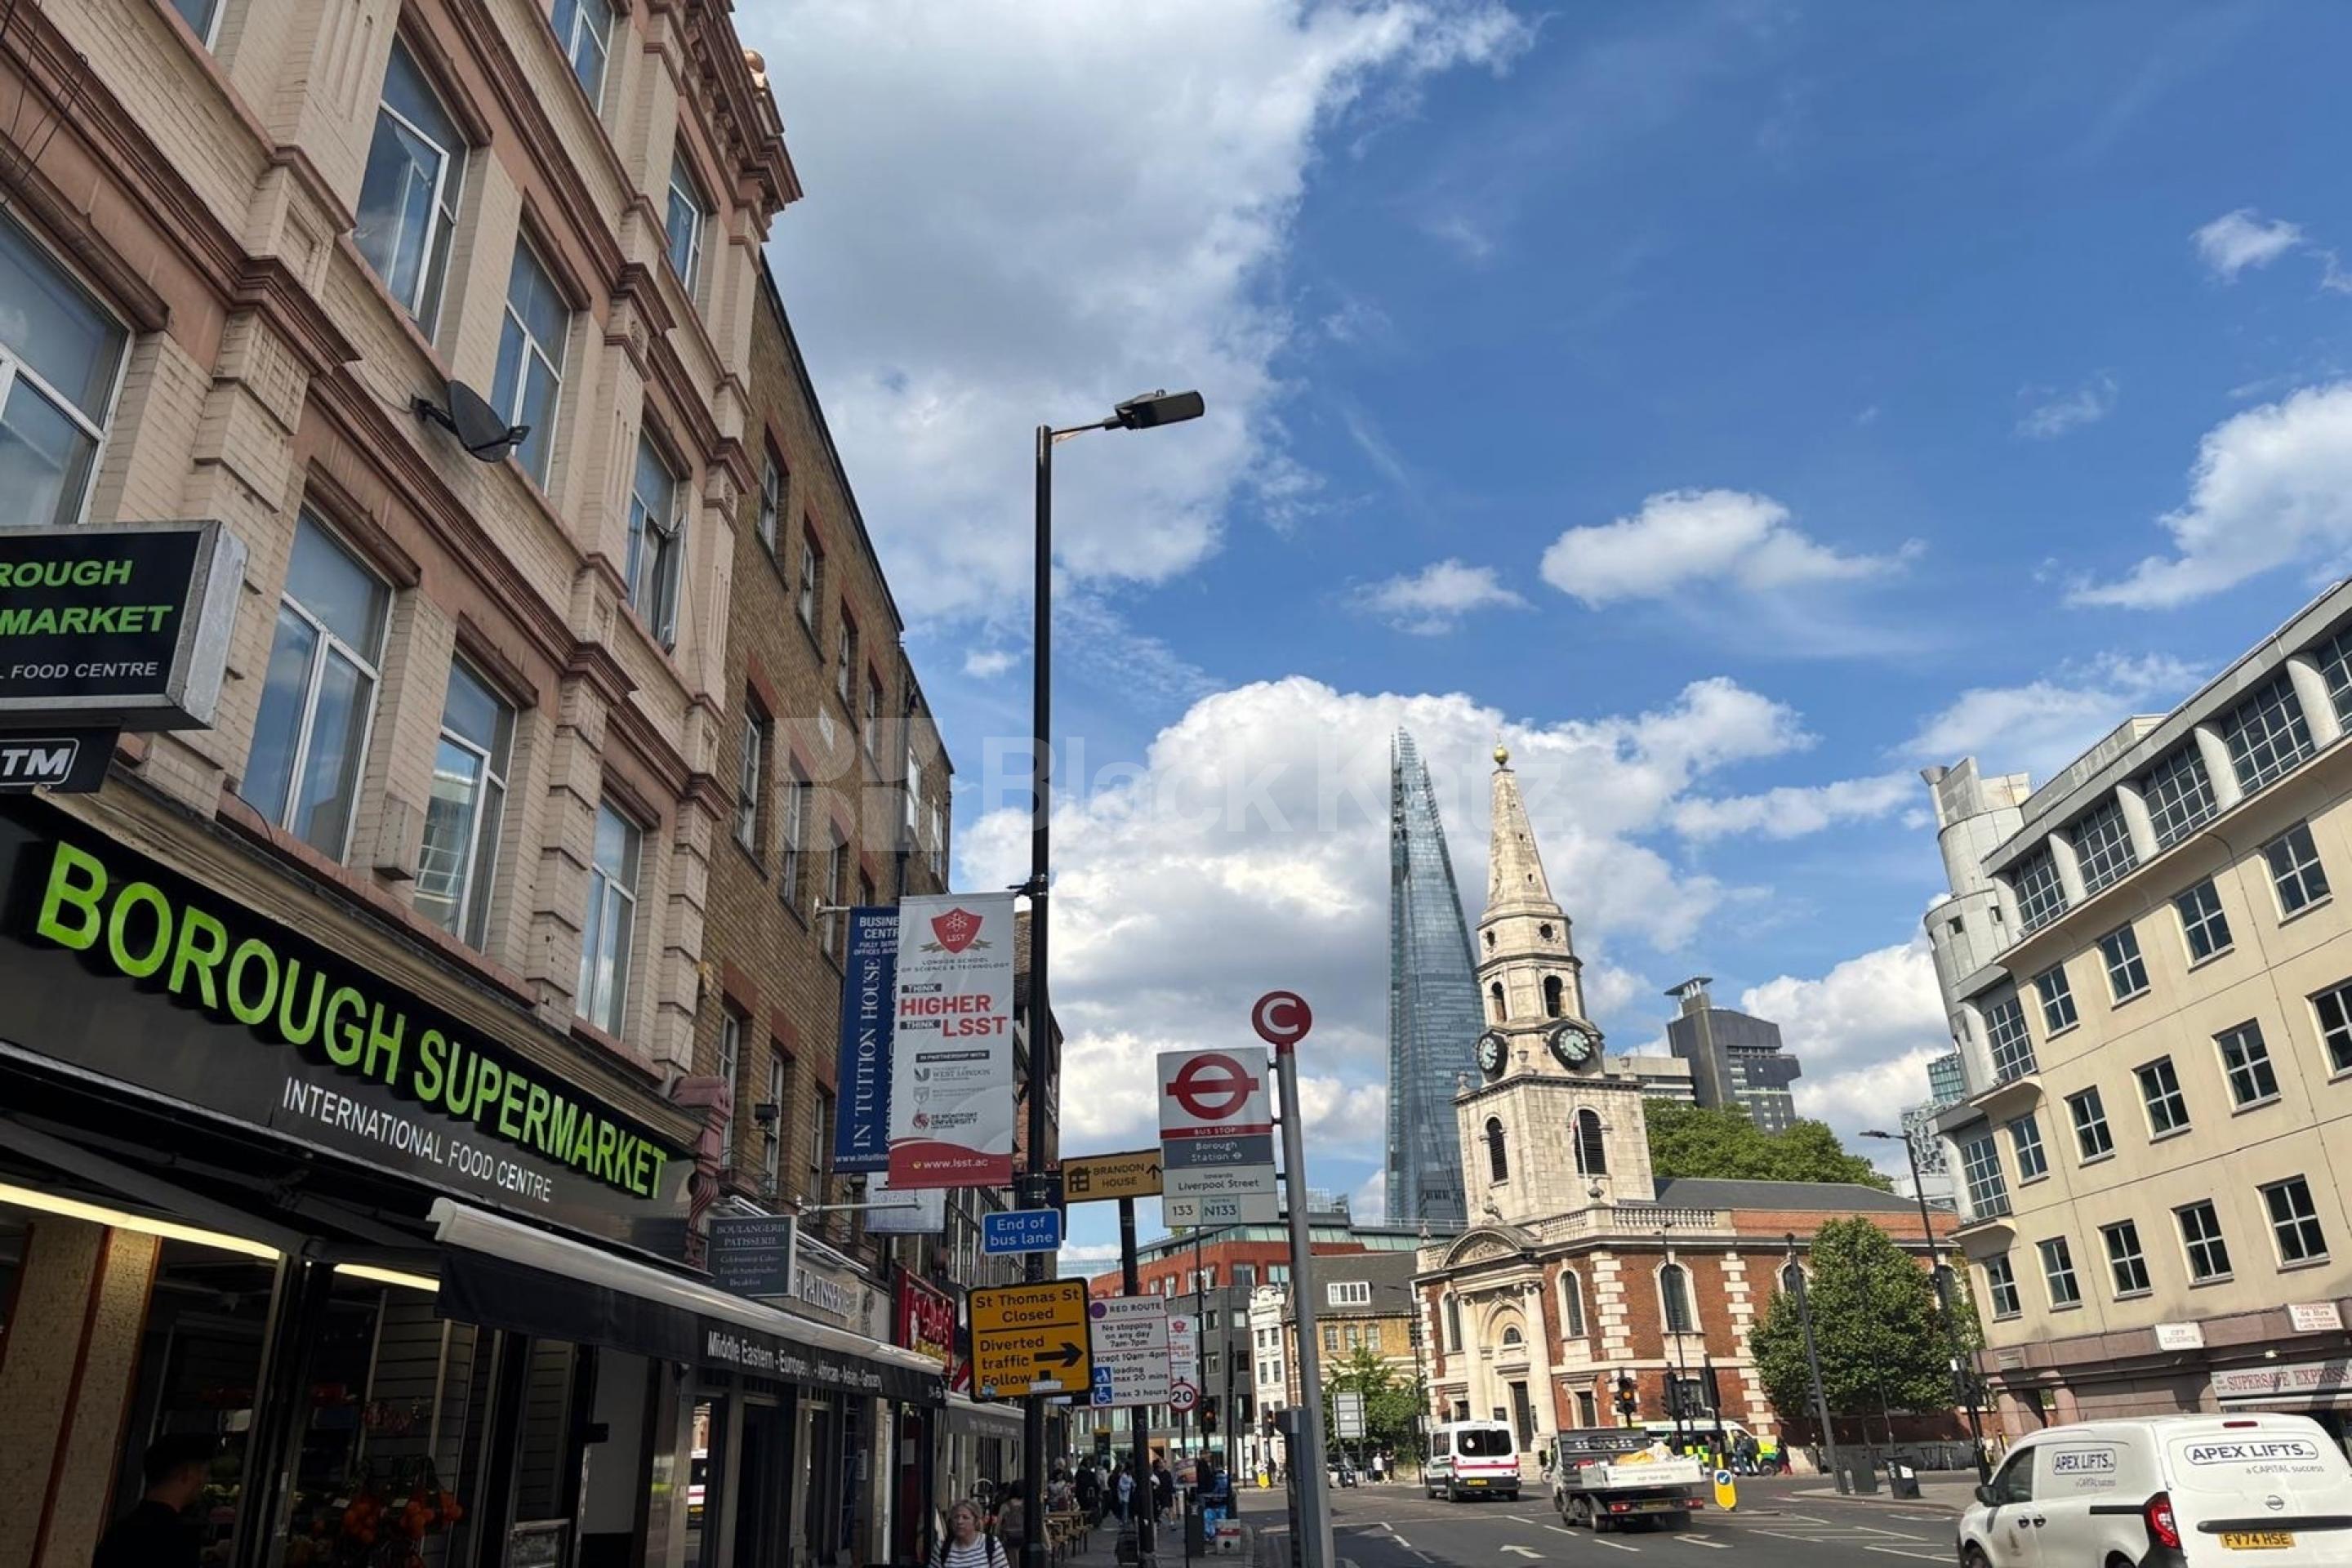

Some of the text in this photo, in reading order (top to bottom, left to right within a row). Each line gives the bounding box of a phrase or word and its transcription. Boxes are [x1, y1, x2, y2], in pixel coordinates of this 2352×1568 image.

[0, 605, 173, 635] MARKET
[11, 664, 69, 679] FOOD
[74, 662, 159, 678] CENTRE
[859, 916, 899, 927] BUSINE
[864, 928, 899, 939] CENT
[947, 933, 967, 942] LSST
[908, 984, 936, 992] THINK
[900, 994, 991, 1016] HIGHER
[36, 840, 407, 1085] BOROUGH
[413, 1029, 667, 1200] SUPERMARKET
[1262, 998, 1299, 1035] C
[906, 1016, 1008, 1036] THINK LSST
[853, 958, 880, 1148] IN TUITION HOUSE
[283, 1076, 552, 1203] INTERNATIONAL FOOD CENTRE
[1196, 1141, 1237, 1152] Borough
[923, 1158, 988, 1169] www.lsst.ac
[1192, 1152, 1229, 1162] Station
[1094, 1163, 1144, 1175] BRANDON
[1102, 1176, 1137, 1188] HOUSE
[1178, 1177, 1259, 1192] Liverpool Street
[1173, 1205, 1193, 1216] 133
[1205, 1205, 1236, 1216] N133
[996, 1216, 1045, 1231] End of
[990, 1232, 1054, 1246] bus lane
[976, 1288, 1080, 1308] St Thomas St
[1131, 1303, 1160, 1312] ROUTE
[1002, 1308, 1054, 1322] Closed
[1116, 1322, 1153, 1332] stopping
[1118, 1332, 1133, 1340] any
[1135, 1330, 1150, 1339] day
[980, 1335, 1045, 1352] Diverted
[707, 1330, 740, 1363] Middle
[742, 1339, 774, 1370] Eastern
[778, 1349, 815, 1379] Europe
[982, 1354, 1029, 1370] traffic
[1113, 1366, 1144, 1374] loading
[982, 1373, 1031, 1386] Follow
[2226, 1371, 2292, 1391] SUPERSAVE
[2293, 1365, 2350, 1386] EXPRESS
[1173, 1390, 1192, 1403] 20
[2192, 1443, 2305, 1461] APEX LIFTS
[2055, 1453, 2109, 1471] APEX LIFTS
[2252, 1466, 2287, 1474] CAPITAL
[2291, 1465, 2324, 1473] success
[2224, 1532, 2290, 1546] FV74 HSE
